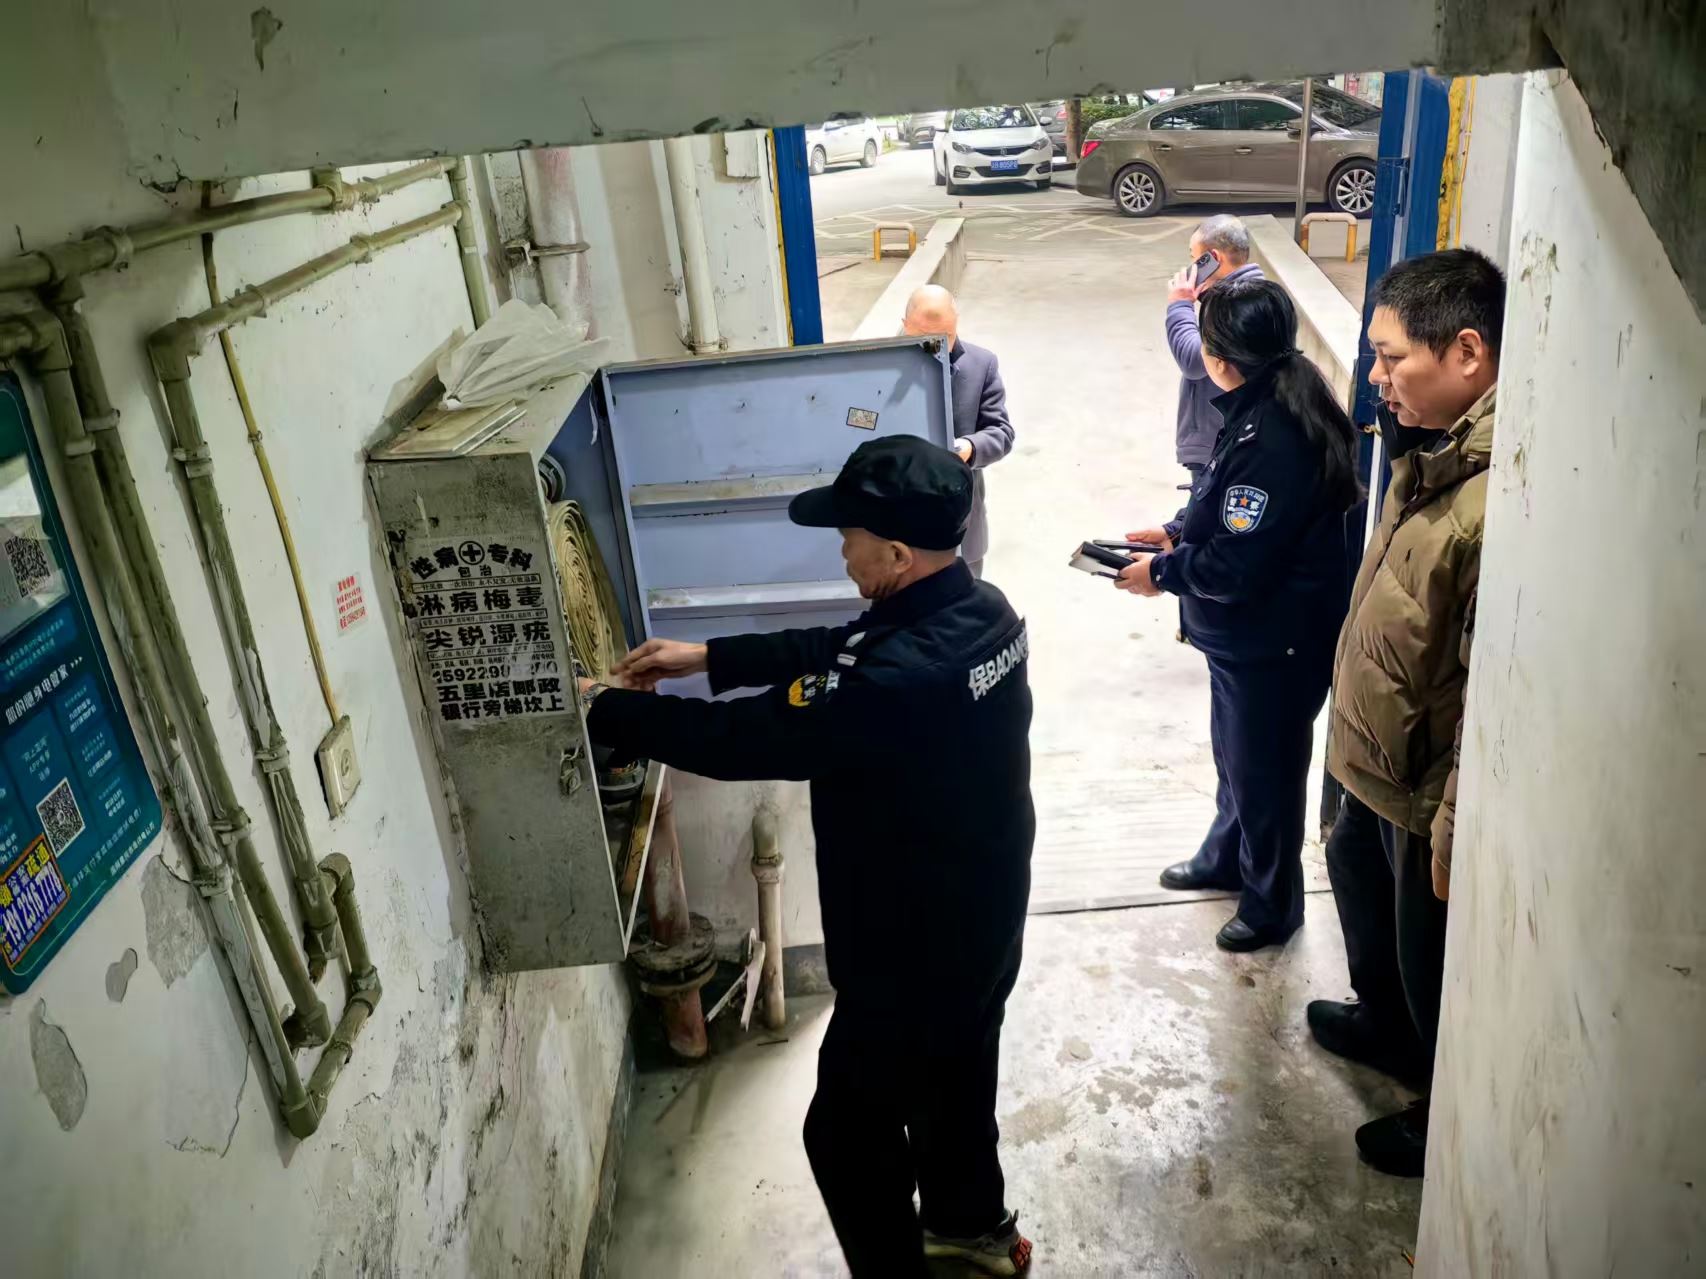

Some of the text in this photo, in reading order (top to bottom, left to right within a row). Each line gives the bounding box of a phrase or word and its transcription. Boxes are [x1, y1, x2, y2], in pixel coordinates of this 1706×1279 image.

[410, 543, 533, 580] 性病 专科
[458, 564, 492, 578] 包治
[417, 587, 545, 617] 淋病梅毒
[427, 621, 552, 650] 尖锐湿疣
[436, 677, 561, 703] 五里店邮政
[440, 695, 565, 721] 银行旁梯坎上
